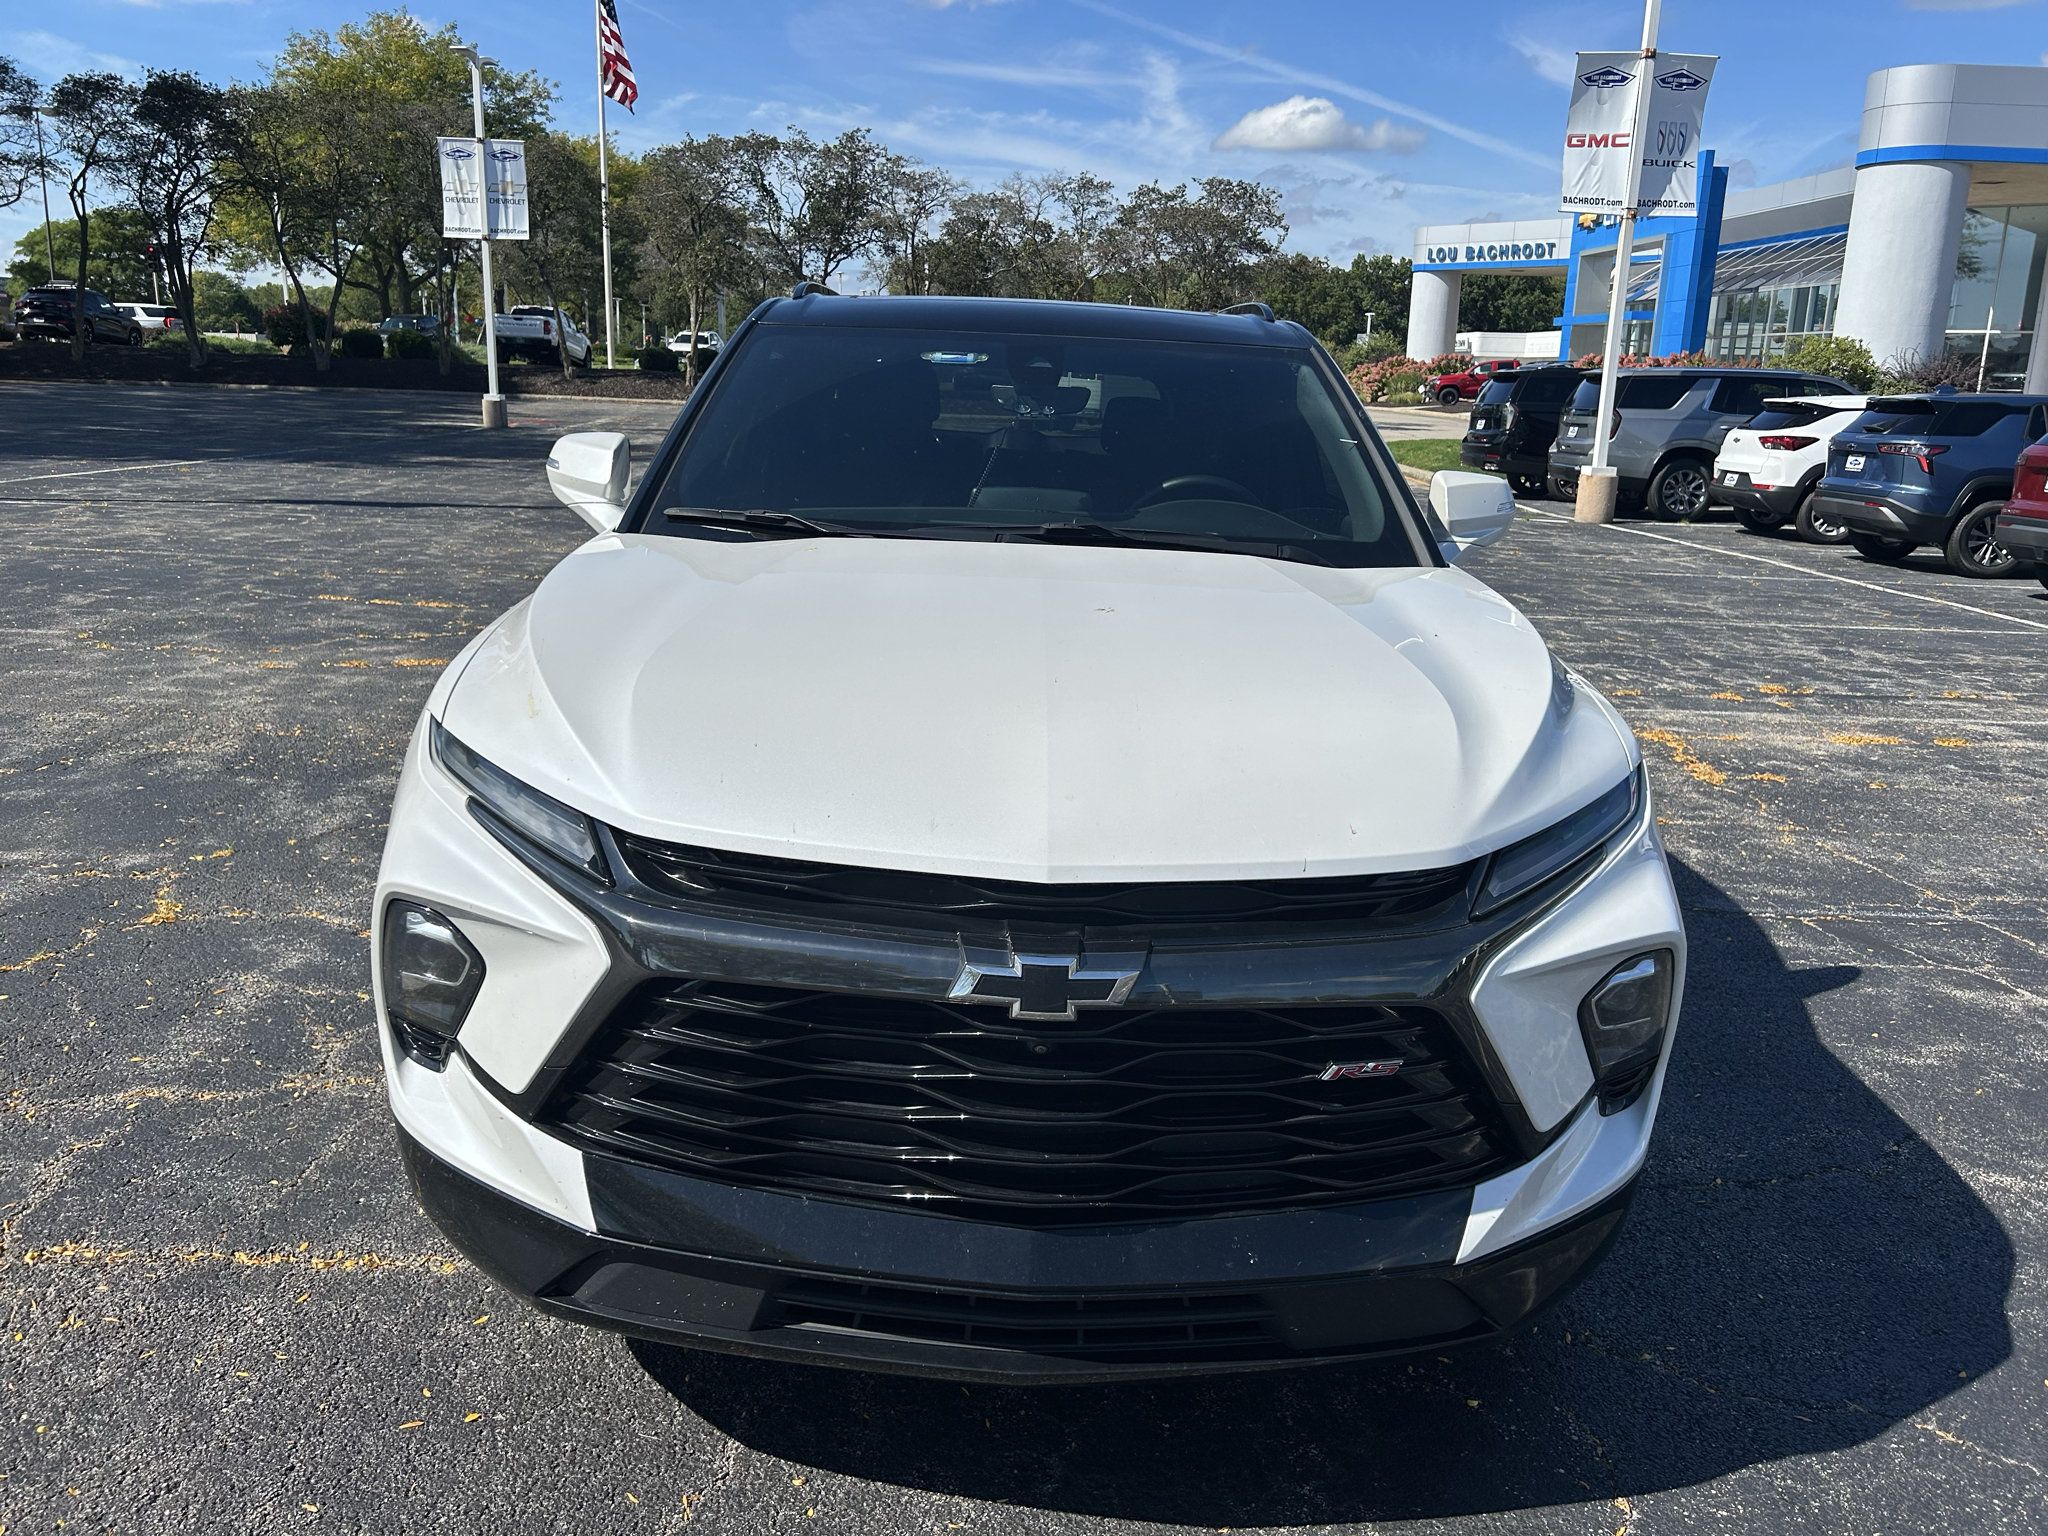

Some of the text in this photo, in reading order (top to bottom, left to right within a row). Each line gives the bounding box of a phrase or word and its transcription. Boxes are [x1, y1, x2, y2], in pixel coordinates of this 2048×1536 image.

[1567, 132, 1631, 148] GMC
[1643, 158, 1696, 169] BUICK
[445, 196, 479, 204] CHEVROLET
[489, 197, 526, 205] CHEVROLET
[1562, 196, 1623, 206] BACHRODT.com
[1637, 199, 1696, 209] BACHRODT.com
[1427, 242, 1557, 263] LOU BACHRODT
[1321, 1062, 1400, 1080] RS
